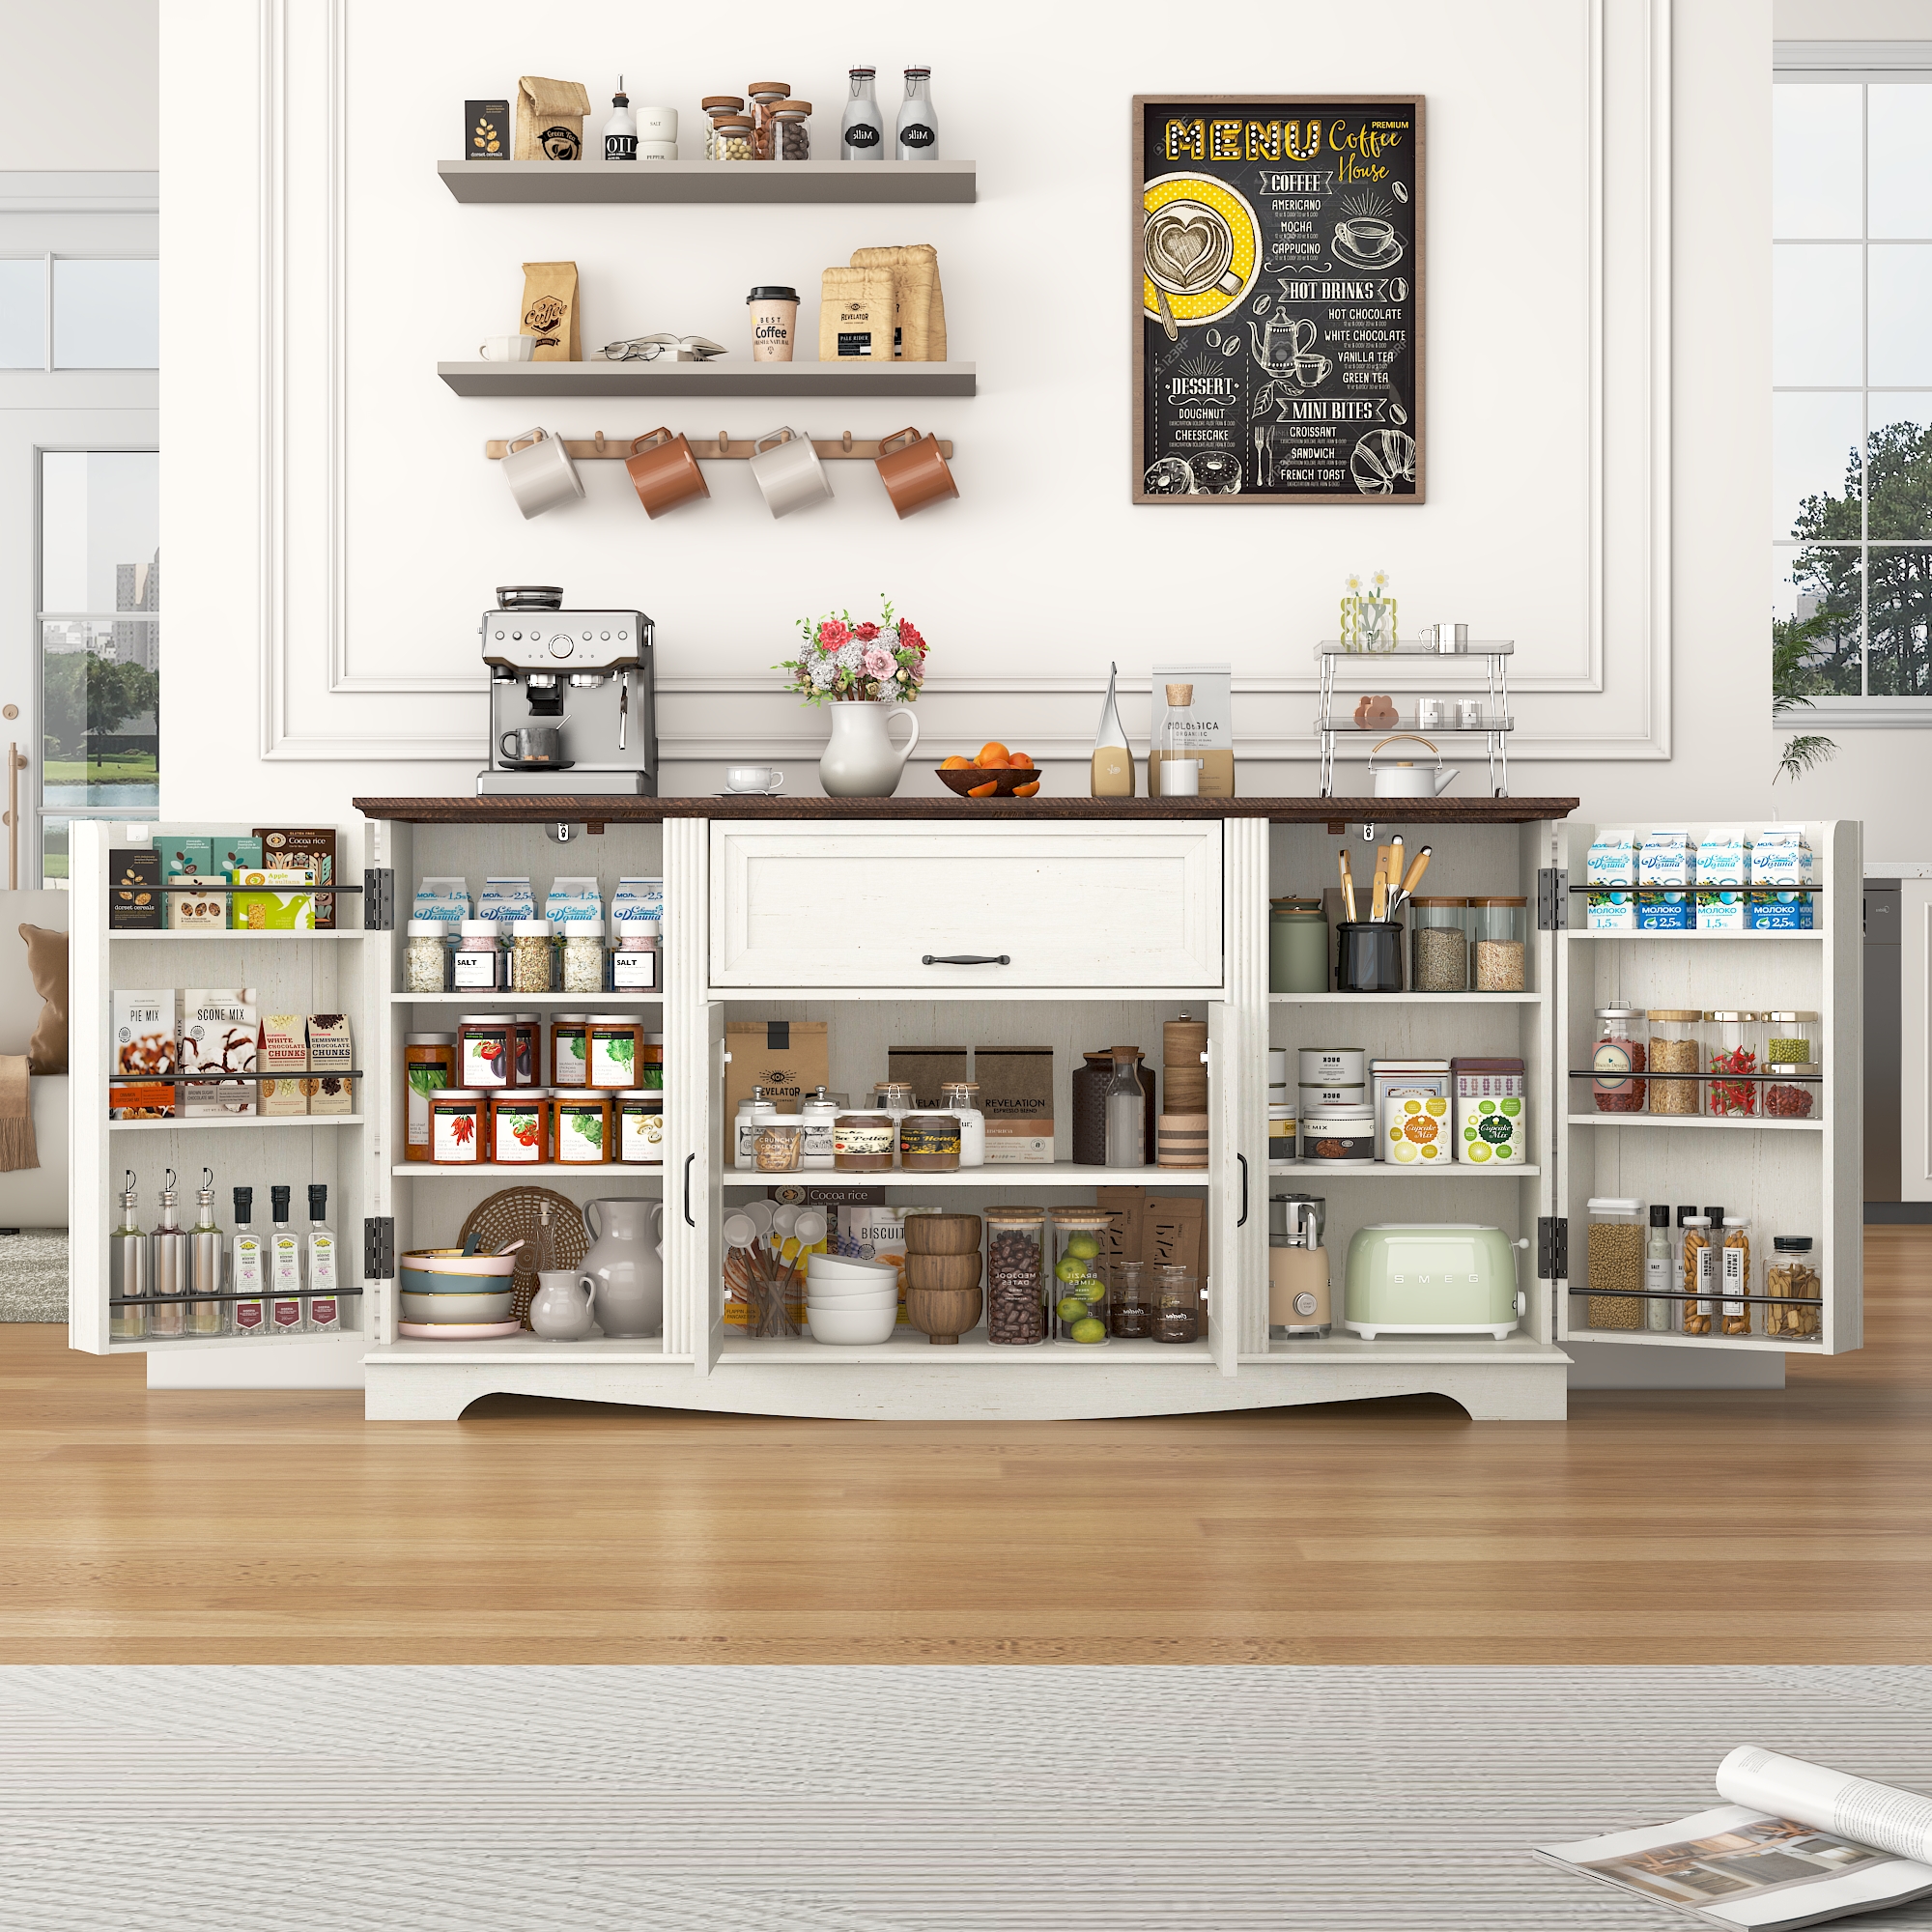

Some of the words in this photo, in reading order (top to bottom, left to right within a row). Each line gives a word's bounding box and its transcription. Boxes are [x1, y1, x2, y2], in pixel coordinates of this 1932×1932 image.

[566, 131, 576, 142] Tea
[1165, 119, 1321, 161] MENU
[1329, 120, 1403, 157] Coffee
[607, 137, 637, 154] OIL
[1338, 153, 1389, 184] House
[1271, 174, 1321, 191] COFFEE
[1272, 199, 1321, 211] AMERICANO
[1281, 221, 1313, 232] MOCHA
[1272, 243, 1321, 254] CAPPUCINO
[1290, 282, 1311, 299] HOT
[1315, 282, 1374, 299] DRINKS
[525, 303, 567, 327] Coffee
[1328, 308, 1347, 320] HOT
[1350, 308, 1402, 320] CHOCOLATE
[755, 327, 787, 338] Coffee
[1324, 330, 1350, 341] WHITE
[1353, 330, 1406, 341] CHOCOLATE
[1338, 352, 1374, 362] VANILLA
[1378, 352, 1394, 362] TEA
[1343, 372, 1369, 384] GREEN
[1372, 372, 1388, 384] TEA
[1172, 378, 1233, 394] DESSERT
[1179, 409, 1225, 419] DOUGHNUT
[1293, 402, 1326, 419] MINI
[1332, 402, 1374, 419] BITES
[1175, 430, 1229, 440] CHEESECAKE
[1290, 426, 1337, 438] CROISSANT
[1292, 447, 1335, 459] SANDWICH
[1281, 469, 1314, 480] FRENCH
[1318, 469, 1346, 480] TOAST
[1588, 857, 1626, 869] Долина
[1642, 857, 1680, 869] Долина
[1697, 856, 1736, 869] Долина
[1753, 856, 1793, 868] Долина
[414, 908, 460, 921] Долина
[480, 908, 527, 922] Долина
[547, 908, 593, 923] Долина
[614, 908, 662, 921] Долина
[1596, 919, 1618, 927] 1,5%
[1660, 918, 1682, 927] 2,5%
[1706, 919, 1728, 928] 1,5%
[1772, 918, 1795, 927] 2,5%
[130, 1010, 142, 1022] PIE
[146, 1010, 159, 1021] MIX
[197, 1009, 225, 1021] SCONE
[229, 1009, 244, 1020] MIX
[758, 1087, 800, 1096] EVELATOR
[1406, 1123, 1435, 1132] Cupcake
[810, 1190, 845, 1200] Cocoa
[848, 1190, 867, 1200] rice
[862, 1227, 904, 1239] BISCUIT
[1394, 1273, 1479, 1284] SMEG
